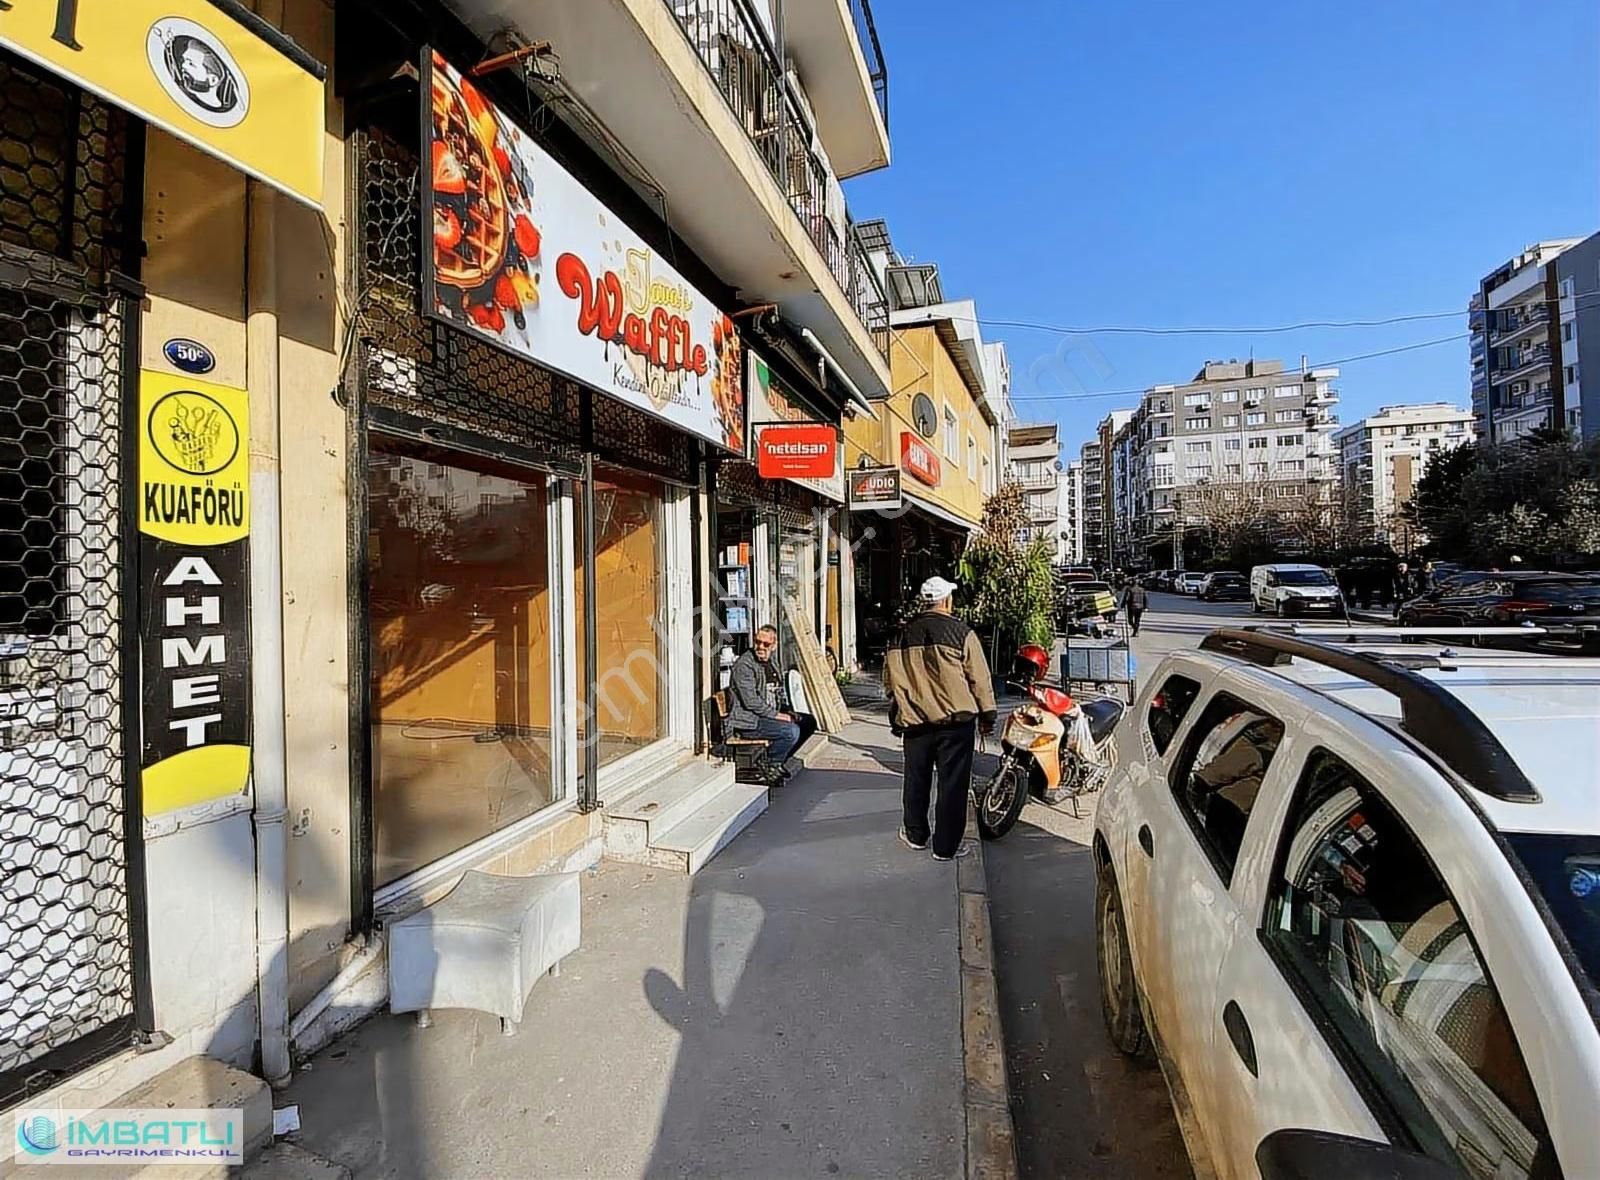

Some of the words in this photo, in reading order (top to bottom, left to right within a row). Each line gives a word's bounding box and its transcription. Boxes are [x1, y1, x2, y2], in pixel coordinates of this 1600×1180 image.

[556, 252, 708, 376] Waffle
[767, 441, 828, 455] netelsan
[145, 479, 245, 527] KUAFÖRÜ
[162, 556, 228, 747] AHMET
